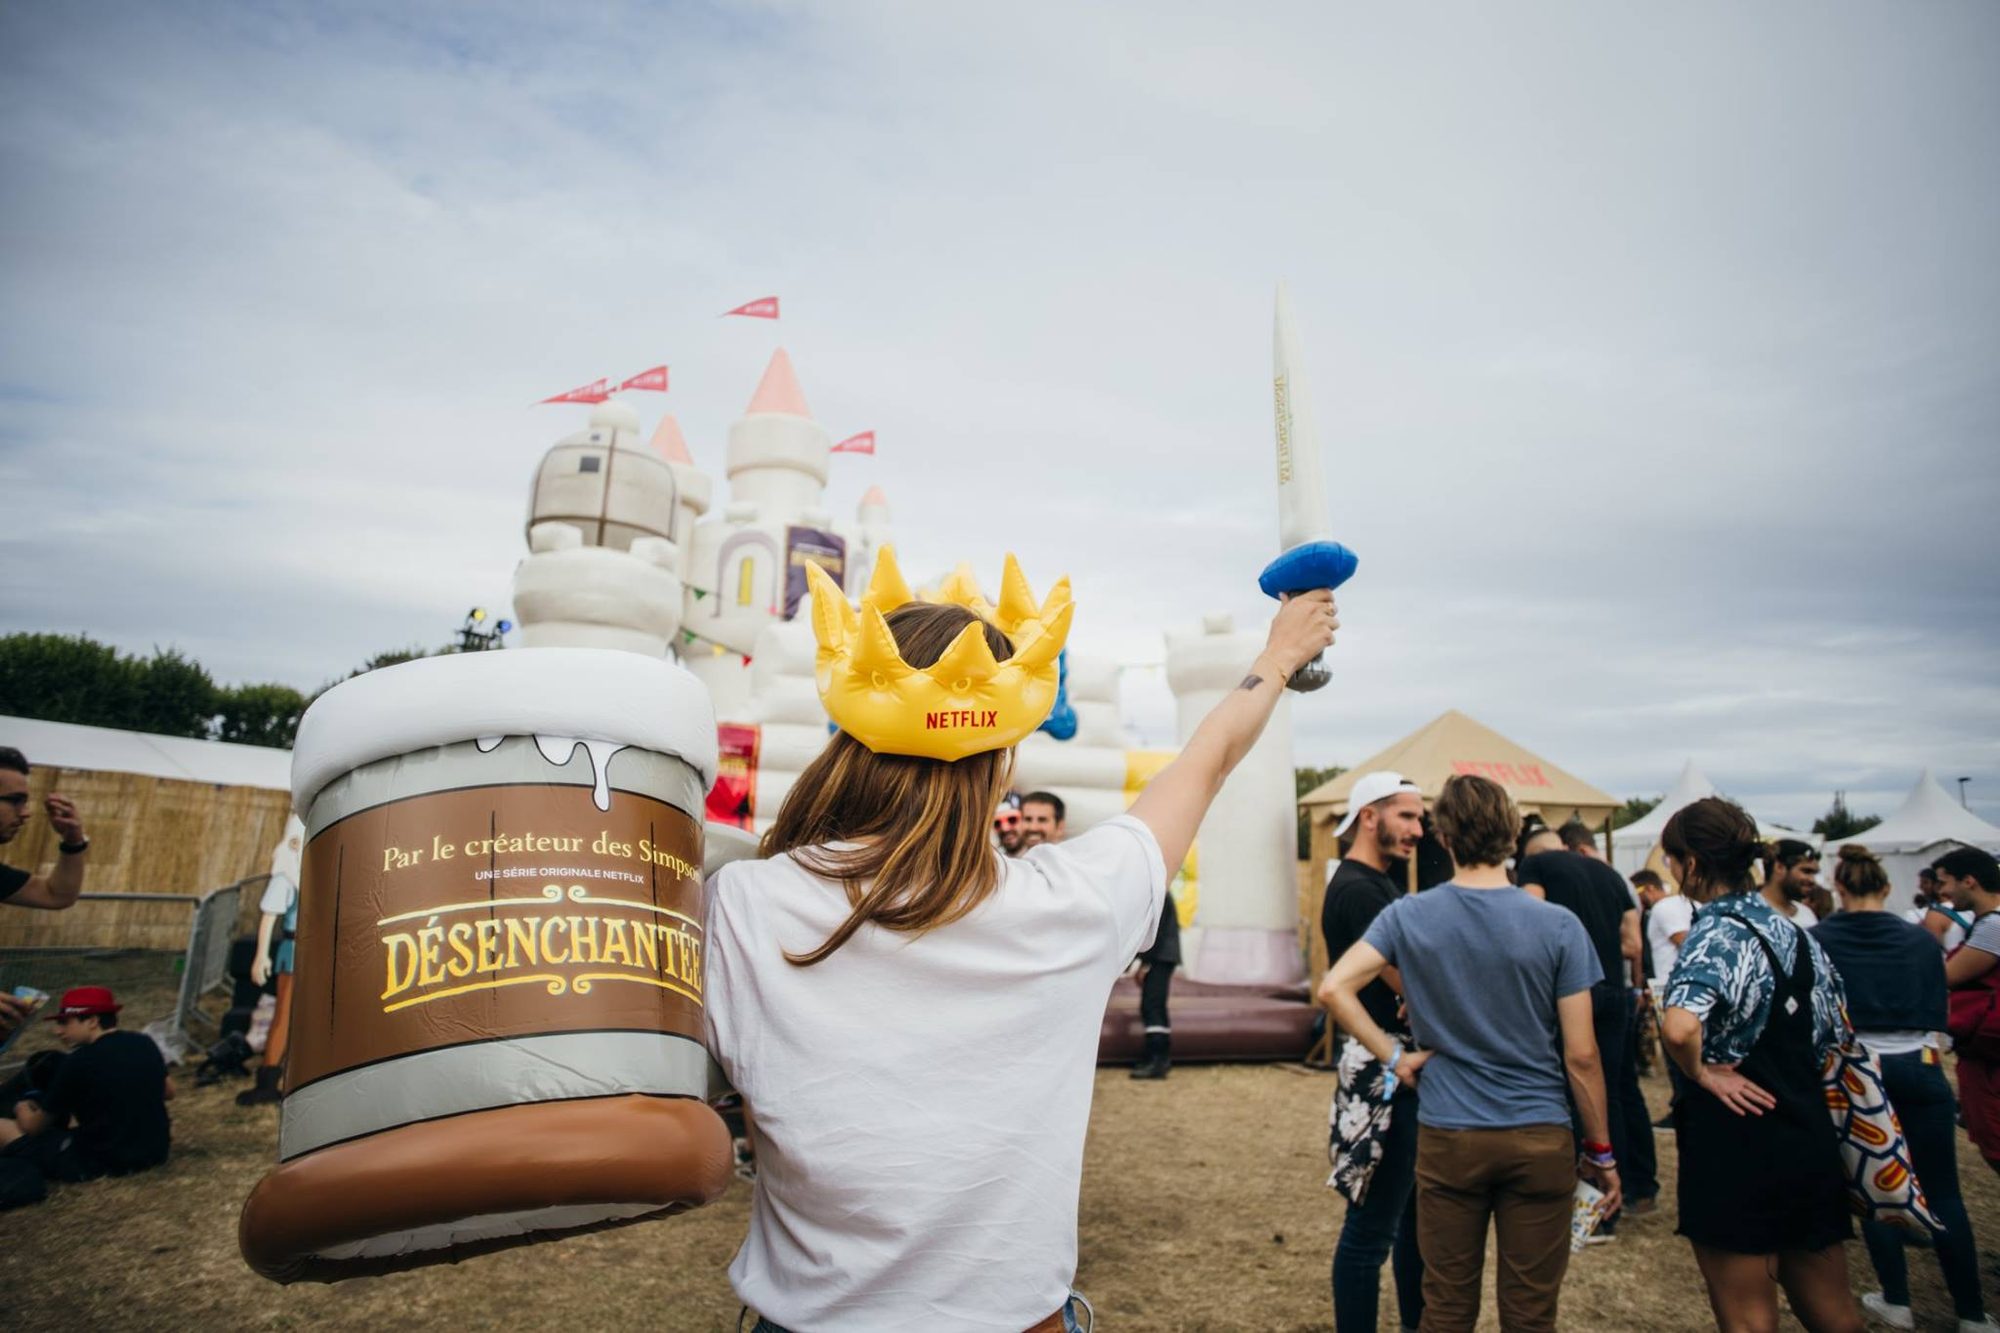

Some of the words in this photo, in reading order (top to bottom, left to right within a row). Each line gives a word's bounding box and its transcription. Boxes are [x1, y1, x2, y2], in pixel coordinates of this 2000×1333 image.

[926, 710, 998, 729] NETFLIX
[383, 847, 423, 871] Par
[431, 834, 456, 861] le
[464, 831, 584, 856] créateur
[592, 831, 632, 857] des
[474, 869, 501, 880] UNE
[503, 866, 537, 879] SÉRIE
[539, 867, 601, 878] ORIGINALE
[603, 871, 644, 884] NETFLIX
[381, 916, 702, 999] DÉSENCHANTÉE
